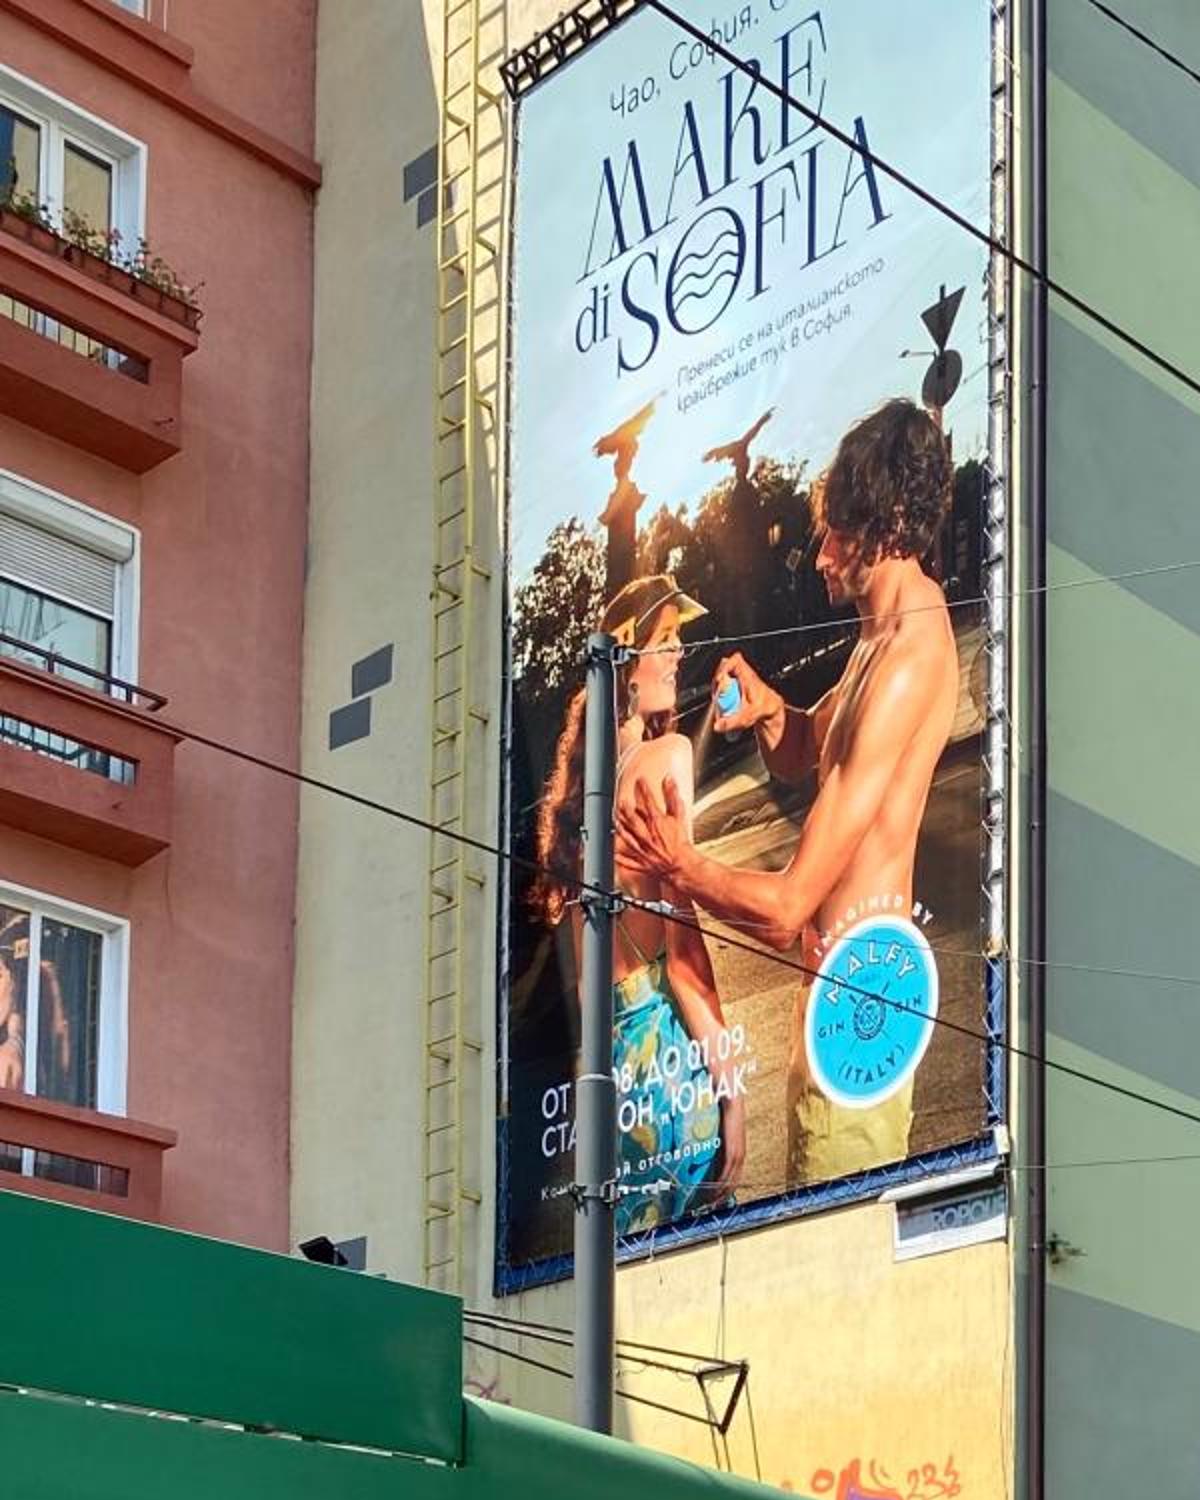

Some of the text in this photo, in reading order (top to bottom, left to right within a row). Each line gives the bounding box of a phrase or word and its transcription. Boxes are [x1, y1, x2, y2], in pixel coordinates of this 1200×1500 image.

[575, 11, 827, 285] MARE
[738, 331, 754, 351] се
[757, 321, 774, 341] на
[911, 901, 934, 926] BY
[824, 938, 918, 1006] MALFY
[817, 1019, 847, 1040] GIN
[541, 1082, 571, 1119] ОТ
[644, 1046, 681, 1093] ДО
[687, 1023, 753, 1071] 01.09.
[638, 1137, 721, 1172] отговорно
